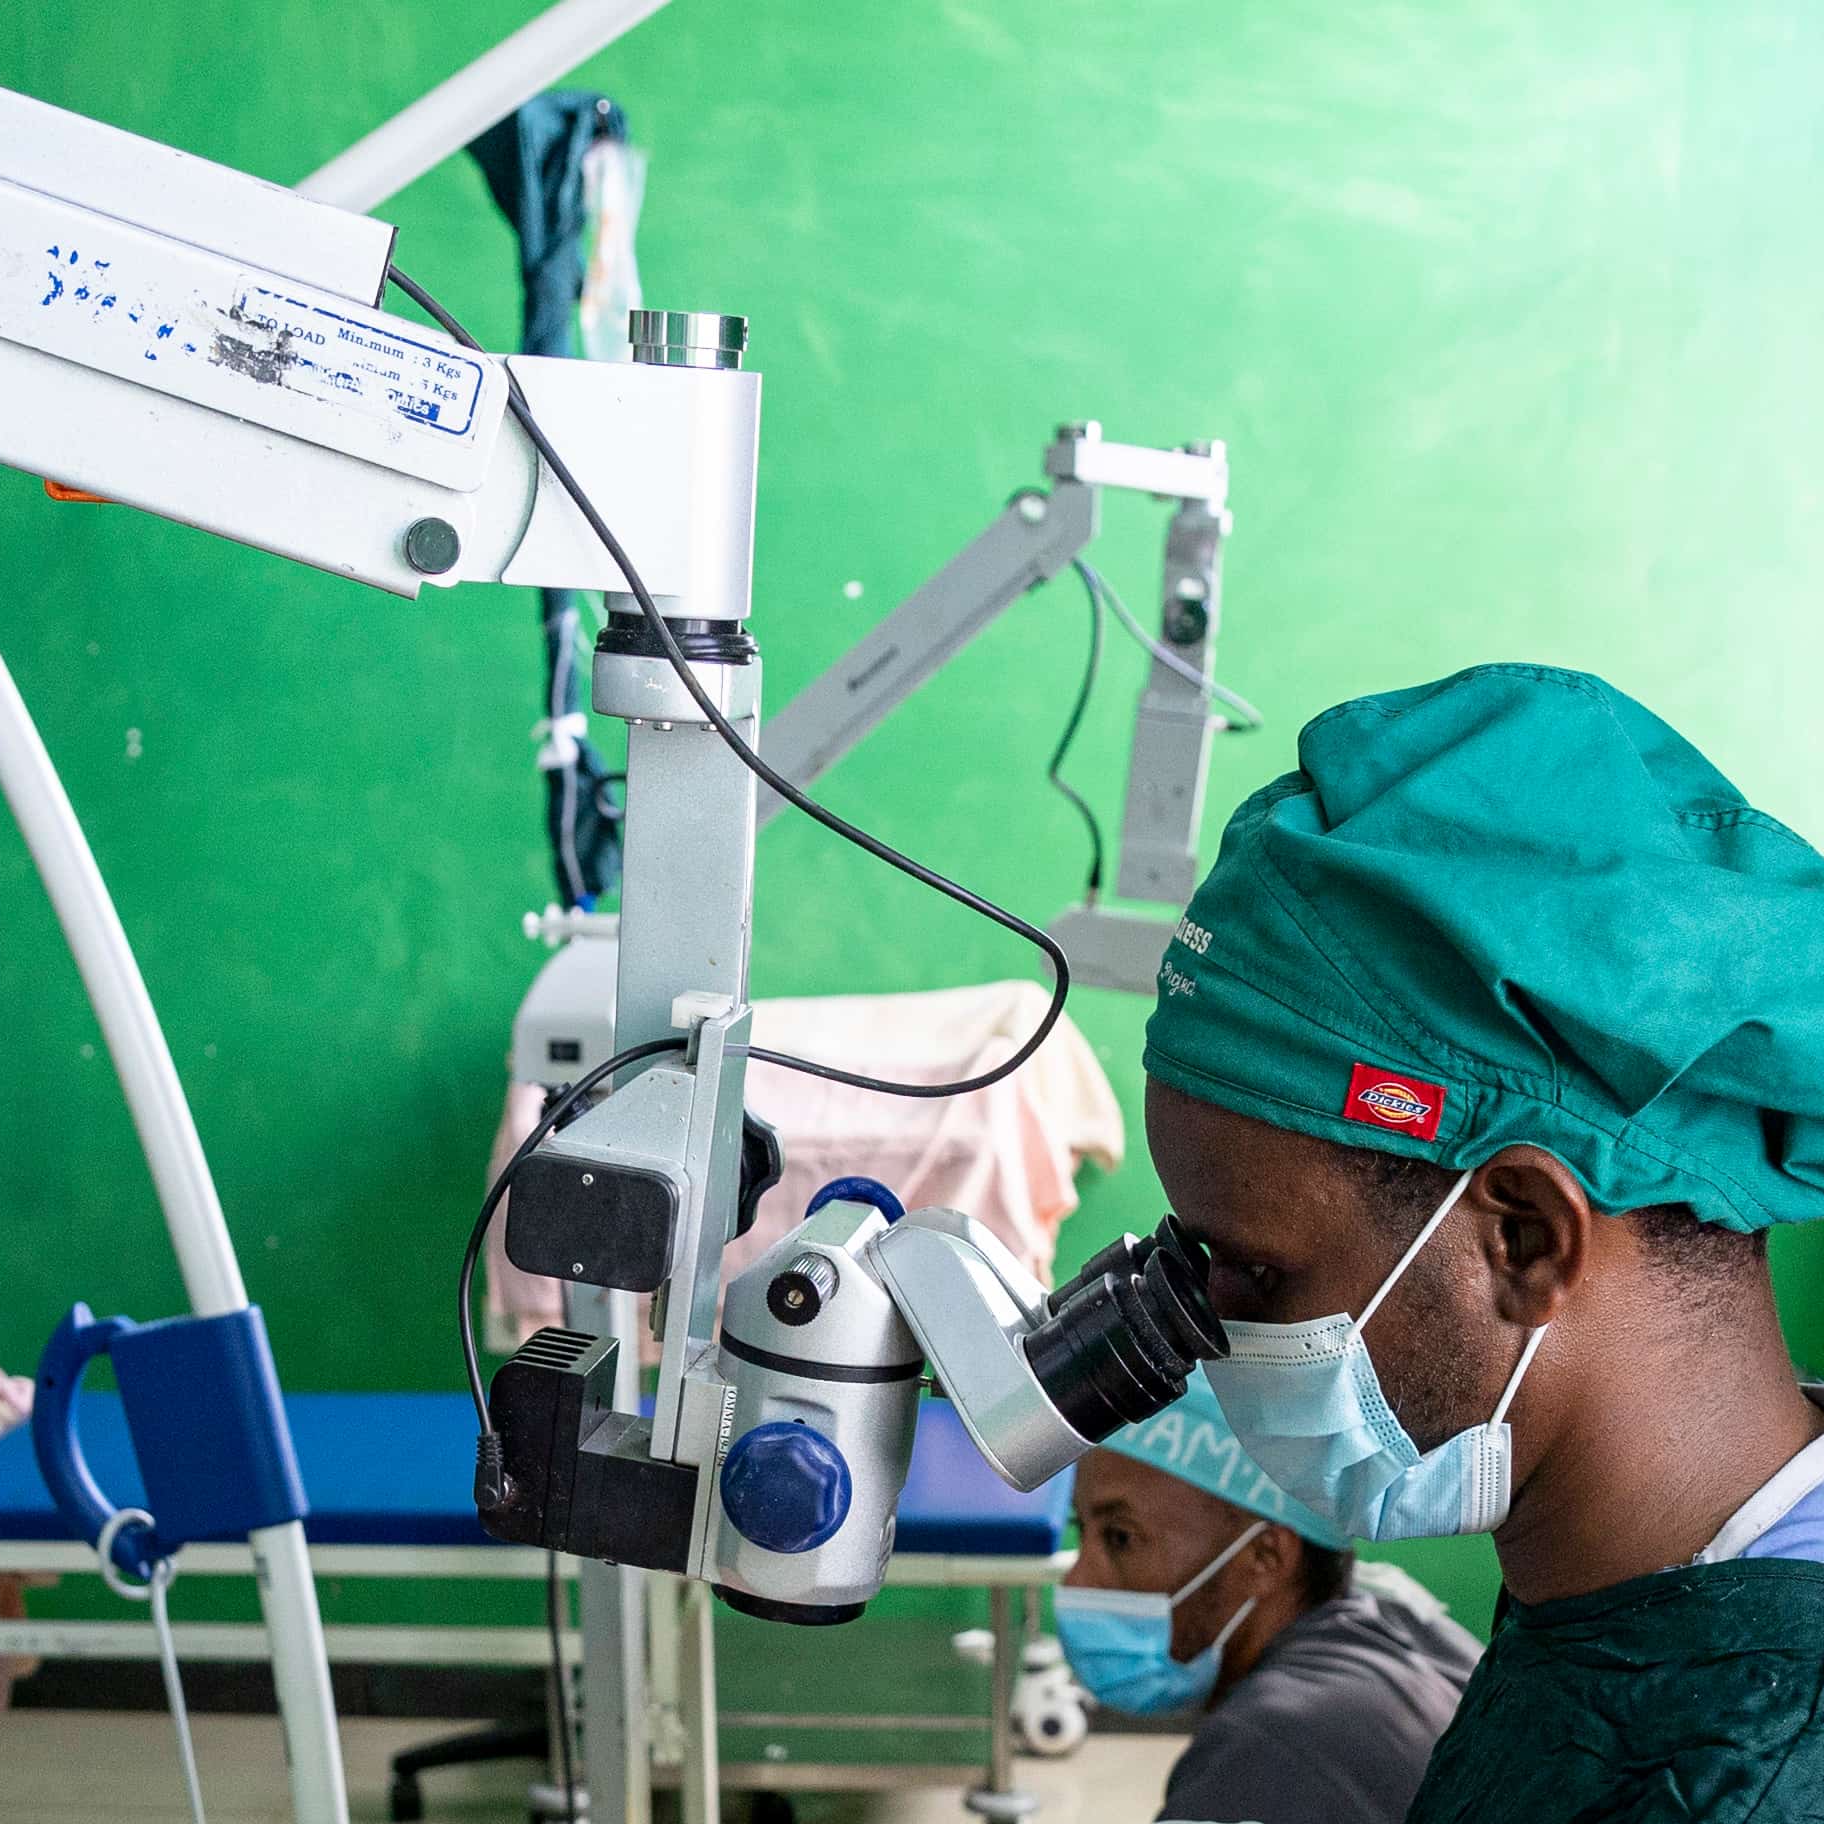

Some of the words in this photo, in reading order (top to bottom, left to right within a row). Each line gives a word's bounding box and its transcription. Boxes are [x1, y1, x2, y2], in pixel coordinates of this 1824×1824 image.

[336, 328, 405, 360] Minmum
[435, 361, 462, 380] Kgs
[1365, 1092, 1424, 1114] Dickies
